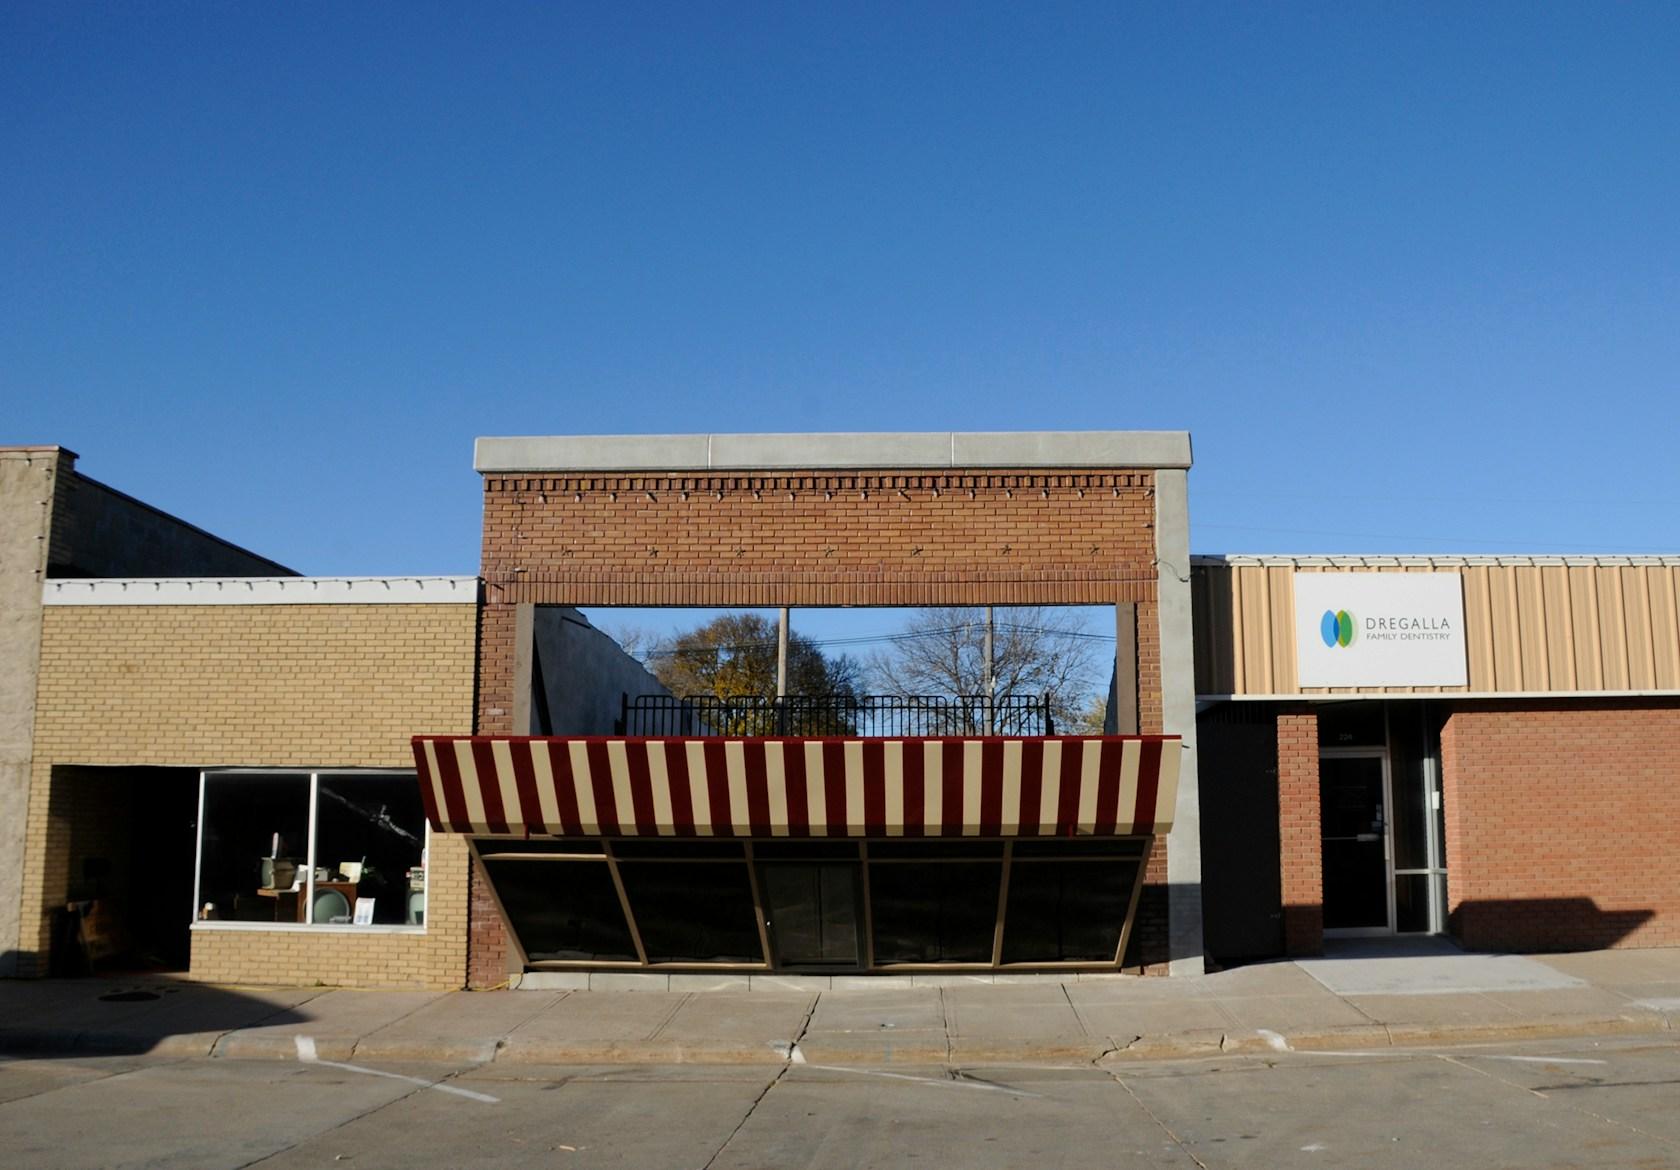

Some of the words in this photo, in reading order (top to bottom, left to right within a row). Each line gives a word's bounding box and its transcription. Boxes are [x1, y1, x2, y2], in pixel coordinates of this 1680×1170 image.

[1366, 617, 1451, 630] DREGALLA
[1366, 633, 1398, 641] FAMILY
[1400, 633, 1451, 641] DENTISTRY
